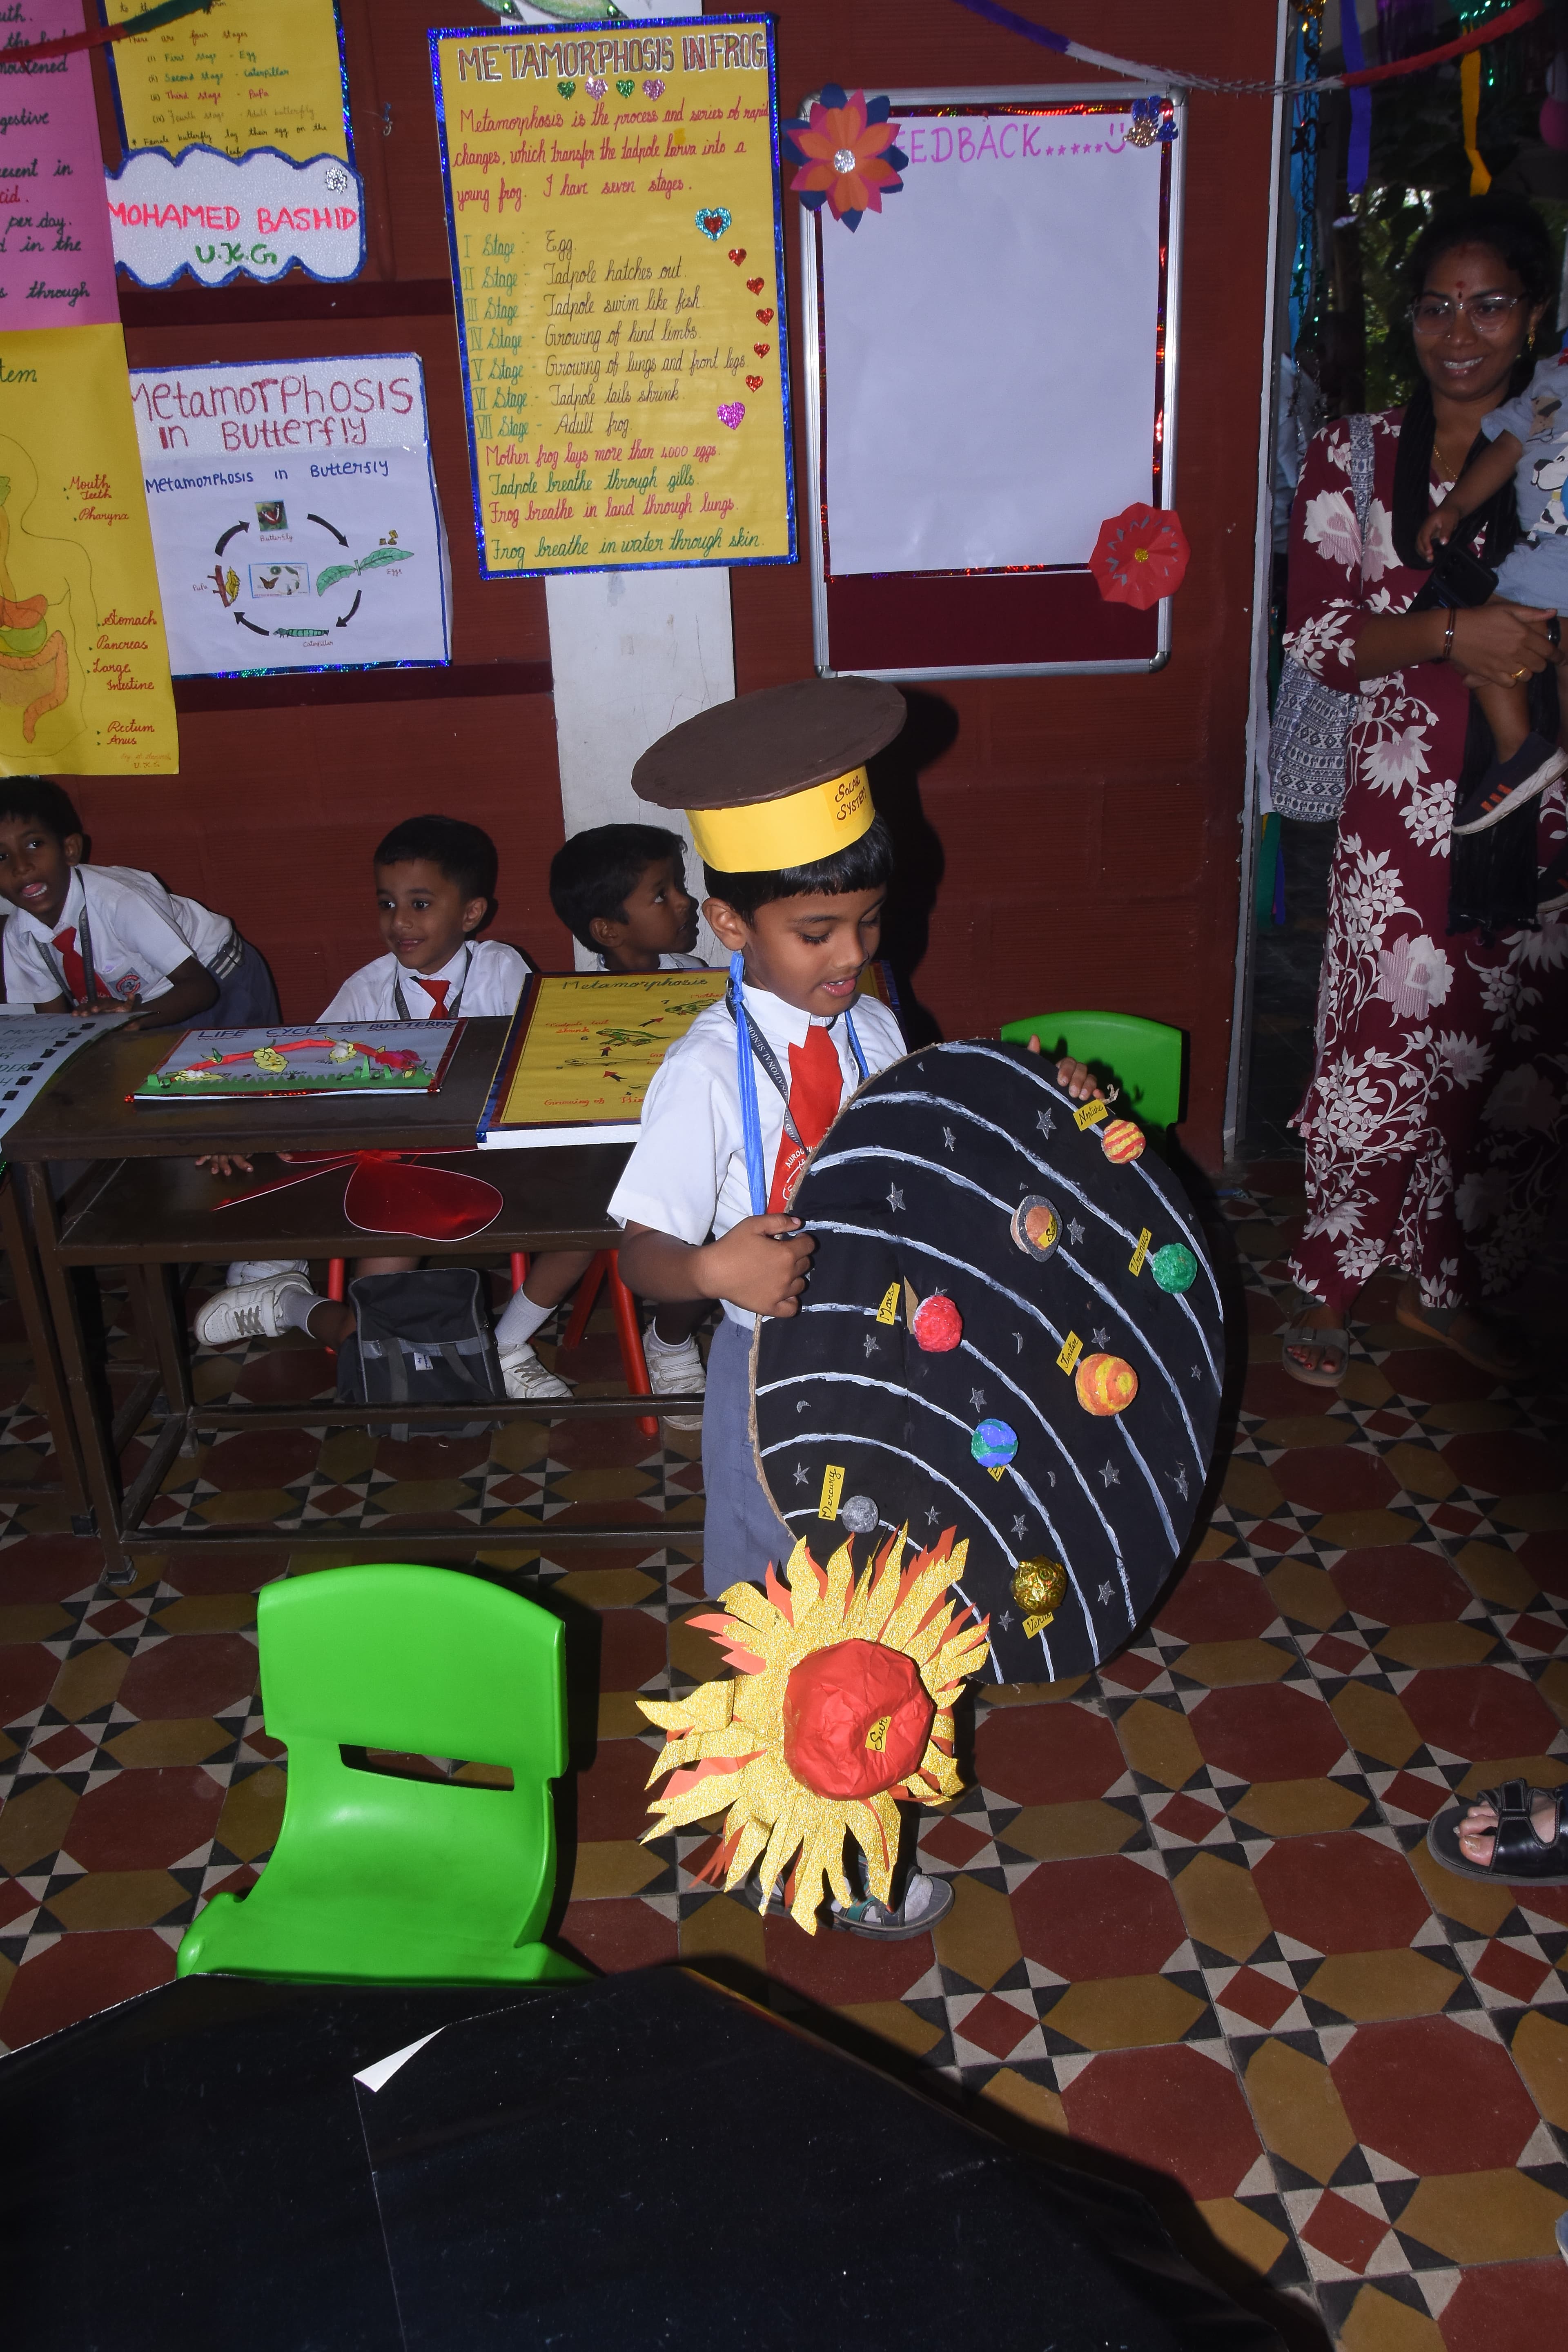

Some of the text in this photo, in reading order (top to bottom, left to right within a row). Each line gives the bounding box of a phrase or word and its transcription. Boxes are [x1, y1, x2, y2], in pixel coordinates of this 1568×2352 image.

[458, 33, 768, 82] METAMORPHOSIS IN FROG
[165, 89, 189, 100] Third
[296, 124, 306, 132] on
[460, 105, 564, 137] Metamorphosis
[571, 111, 586, 128] is
[591, 102, 610, 127] the
[613, 109, 658, 131] process
[662, 97, 685, 122] and
[689, 108, 724, 122] series
[726, 95, 742, 120] of
[510, 140, 546, 164] which
[550, 140, 595, 169] transfer
[599, 136, 616, 160] the
[620, 134, 660, 164] tadpole
[664, 133, 697, 158] larva
[702, 131, 726, 156] into
[734, 141, 747, 154] a
[456, 185, 489, 212] young
[559, 173, 588, 196] have
[601, 180, 636, 195] seven
[109, 202, 241, 232] MOHAMED
[543, 258, 596, 291] Tadpole
[604, 257, 652, 281] hatches
[543, 291, 595, 321] Tadpole
[644, 287, 668, 311] like
[627, 318, 656, 342] hind
[625, 351, 656, 379] lungs
[661, 349, 684, 371] and
[688, 352, 719, 376] front
[549, 383, 596, 412] Tadpole
[554, 412, 594, 435] Adult
[486, 443, 530, 466] Mother
[535, 444, 559, 470] frog
[564, 441, 588, 469] lays
[595, 446, 622, 461] more
[627, 438, 654, 460] than
[69, 474, 111, 490] Mouth
[489, 471, 538, 499] Tadpole
[545, 469, 595, 493] breathe
[604, 466, 657, 495] through
[79, 506, 129, 526] Pharynx
[489, 501, 520, 529] Frog
[525, 497, 574, 521] breathe
[583, 502, 597, 518] in
[605, 495, 635, 517] land
[642, 492, 692, 520] through
[493, 540, 526, 569] Frog
[534, 535, 588, 557] breathe
[598, 537, 617, 554] in
[621, 531, 663, 553] water
[668, 528, 722, 561] through
[102, 609, 157, 626] Stomach
[96, 635, 149, 650] Pancreas
[93, 658, 131, 679] Large
[106, 677, 154, 691] Intestine
[107, 719, 155, 733] Rectum
[106, 735, 137, 746] Anus
[562, 977, 708, 991] Metamorphosis
[198, 1029, 249, 1038] LIFE
[266, 1026, 329, 1035] CYCLE
[870, 1718, 888, 1750] Sun
